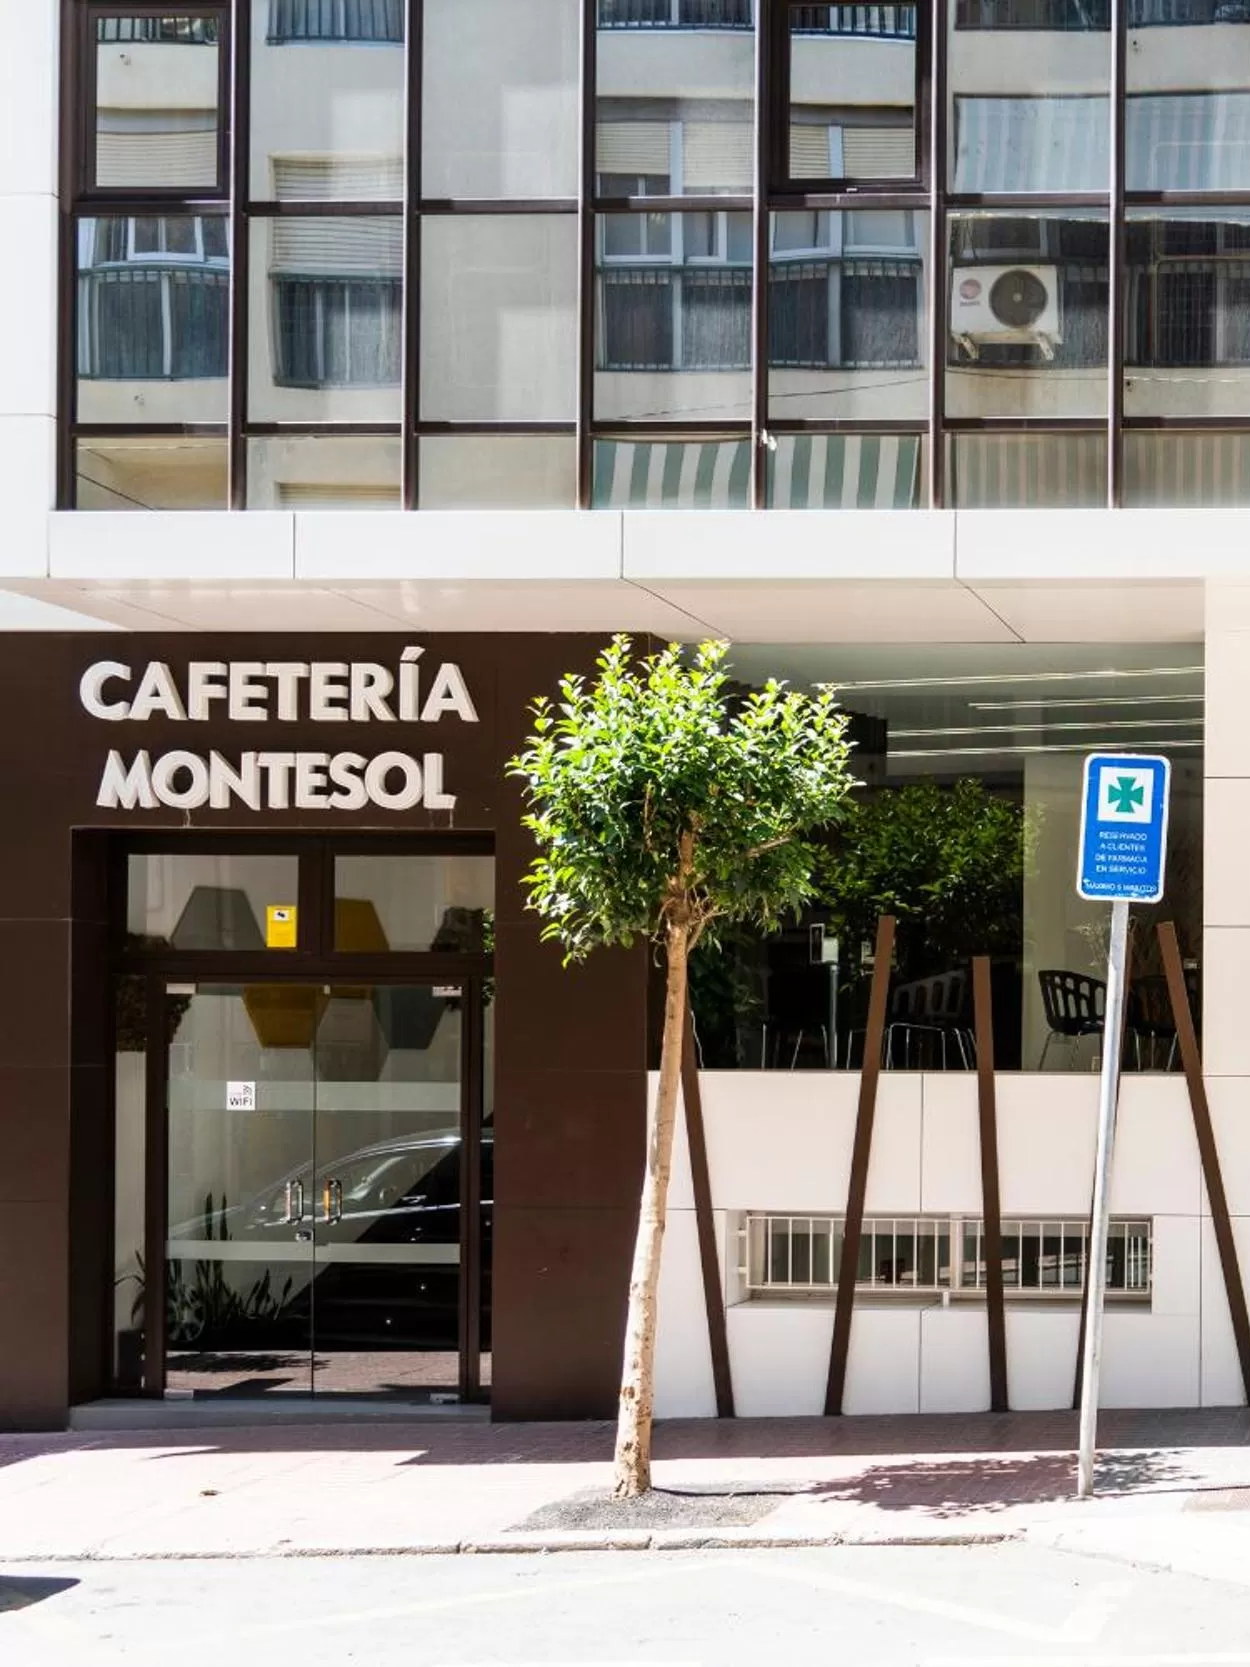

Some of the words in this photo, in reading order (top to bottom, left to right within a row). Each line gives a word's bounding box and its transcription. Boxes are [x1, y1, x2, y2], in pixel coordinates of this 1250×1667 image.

[79, 646, 480, 722] CAFETERÍA
[96, 749, 458, 811] MONTESOL
[1099, 831, 1148, 841] RESERVADO
[1095, 853, 1106, 861] DE
[1096, 864, 1107, 873] EN
